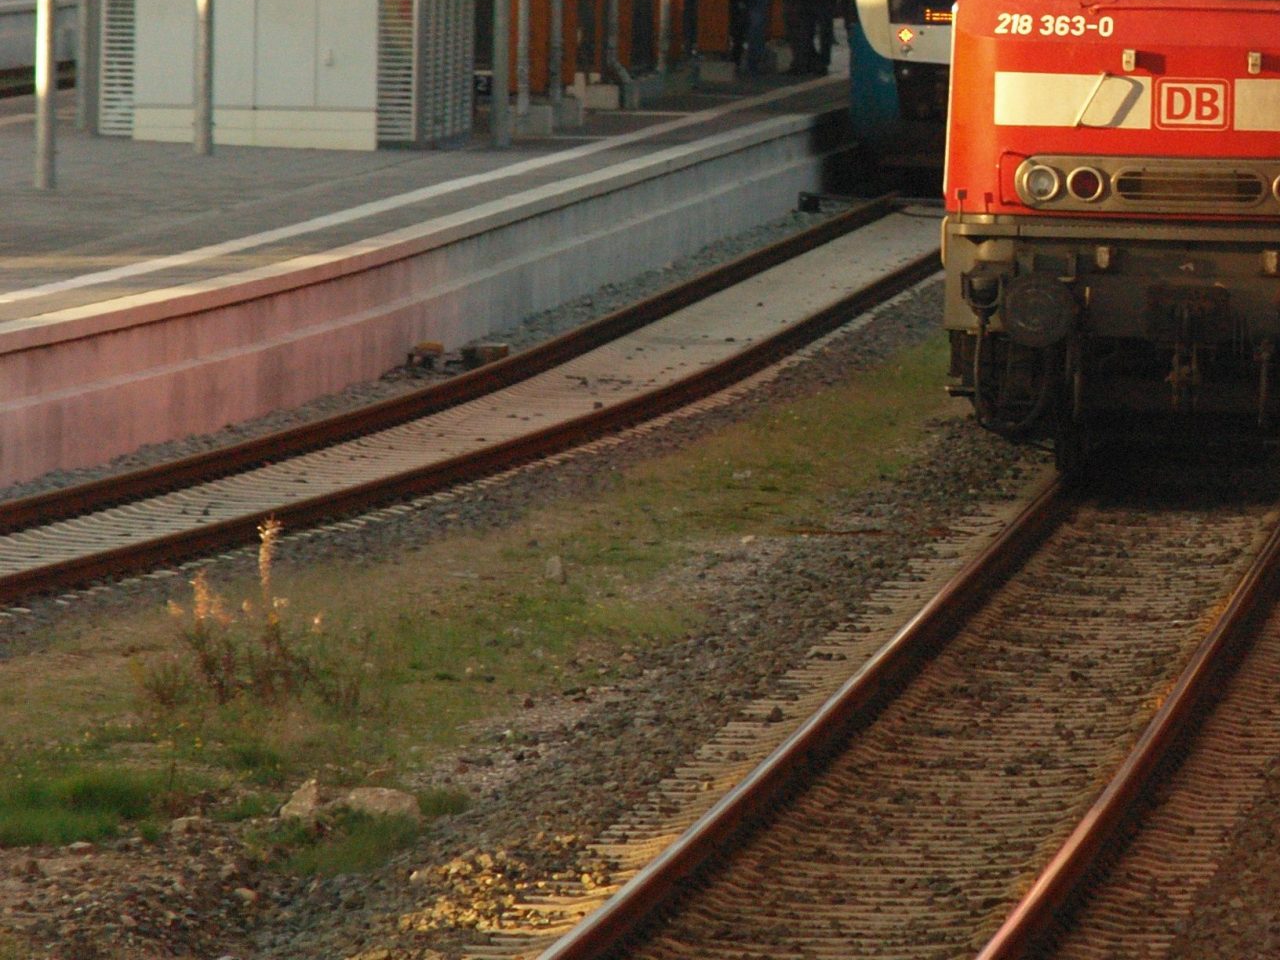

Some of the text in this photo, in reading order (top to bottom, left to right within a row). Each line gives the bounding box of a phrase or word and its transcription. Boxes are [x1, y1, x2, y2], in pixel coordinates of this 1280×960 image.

[994, 12, 1114, 37] 218 363-0
[1166, 86, 1220, 121] DB
